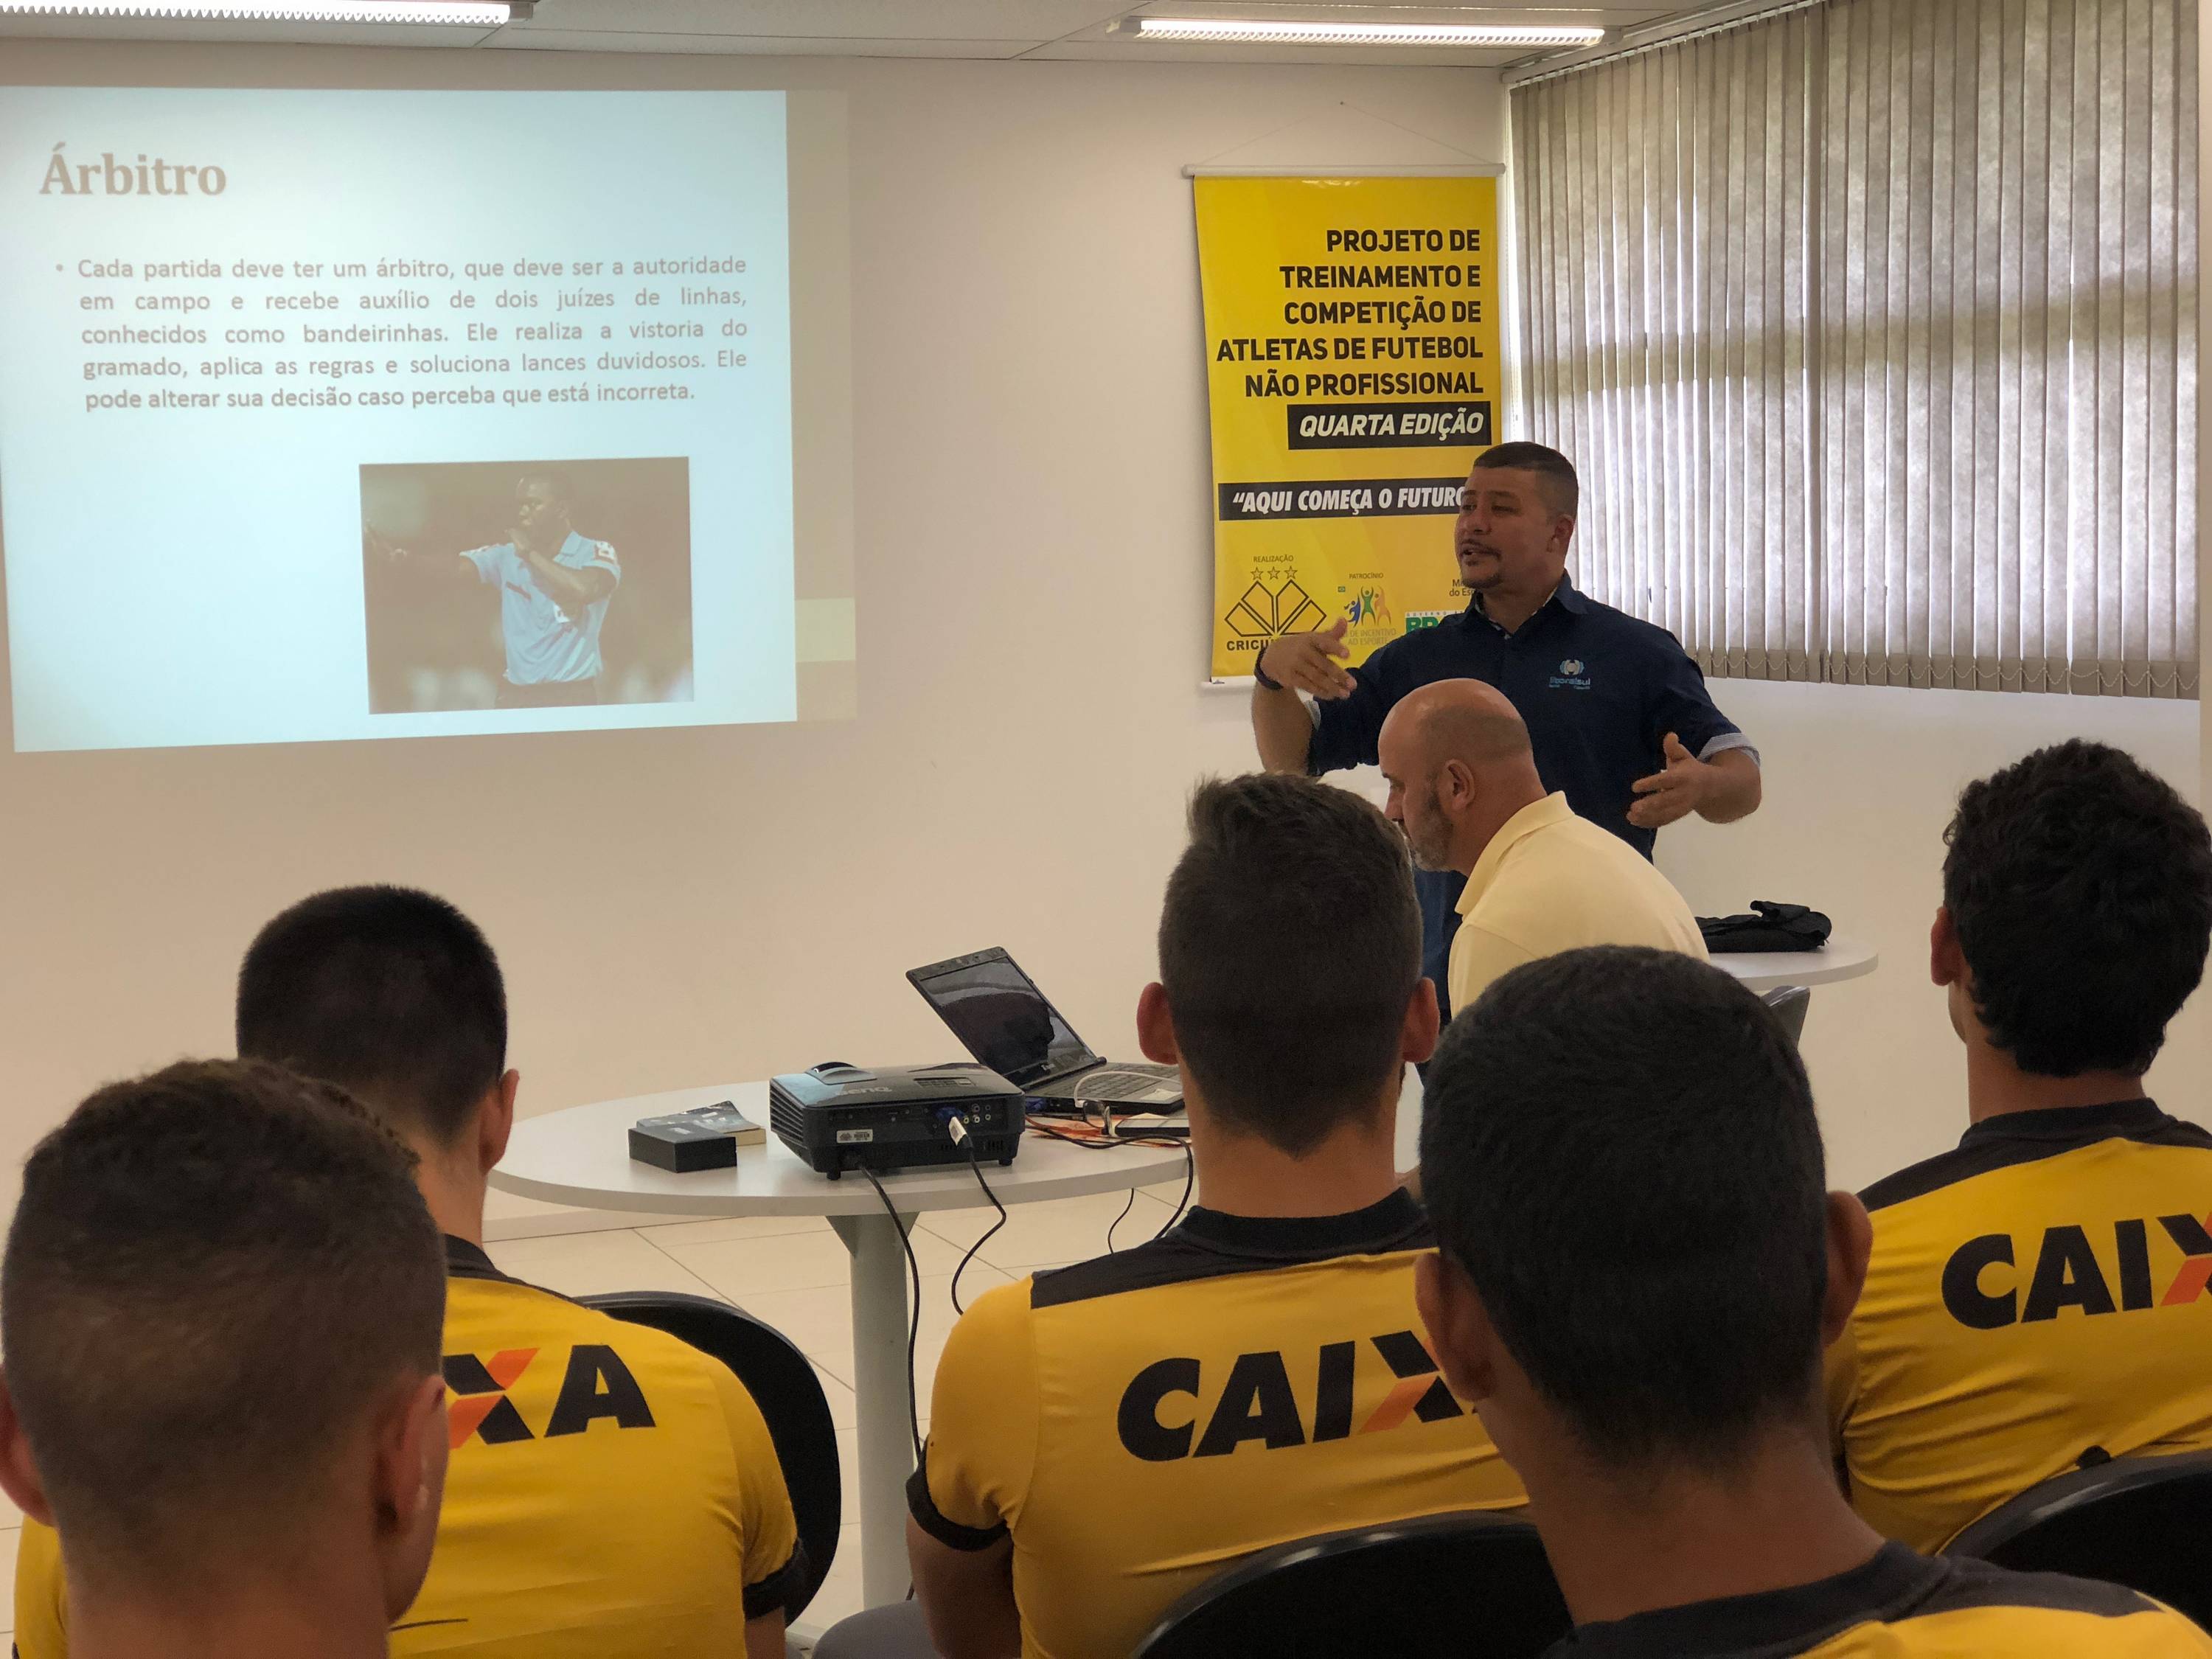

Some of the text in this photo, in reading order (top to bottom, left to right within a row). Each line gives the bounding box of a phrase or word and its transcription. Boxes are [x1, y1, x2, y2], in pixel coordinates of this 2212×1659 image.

[39, 141, 227, 195] Árbitro
[1327, 229, 1480, 252] PROJETO DE
[78, 256, 746, 281] Cada partida deve ter um árbitro, que deve ser a autoridade
[1279, 265, 1480, 288] TREINAMENTO E
[80, 287, 746, 314] em campo e recebe auxílio de dois juízes de linhas,
[1284, 296, 1481, 330] COMPETIÇÃO DE
[82, 319, 747, 344] conhecidos como bandeirinhas. Ele realiza a vistoria do
[1217, 336, 1483, 361] ATLETAS DE FUTEBOL
[83, 350, 746, 380] gramado, aplica as regras e soluciona lances duvidosos. Ele
[1246, 369, 1483, 397] NÃO PROFISSIONAL
[85, 382, 695, 412] pode alterar sua decisão caso perceba que está incorreta.
[1299, 407, 1484, 441] QUARTA EDIÇÃO
[1298, 489, 1372, 515] COMEÇA
[1378, 489, 1392, 509] O
[1253, 554, 1294, 563] REALIZAÇÃO
[1349, 571, 1384, 580] PATROCÍNIO
[1941, 1211, 2212, 1329] CAIX
[1117, 1330, 1481, 1461] CAIX
